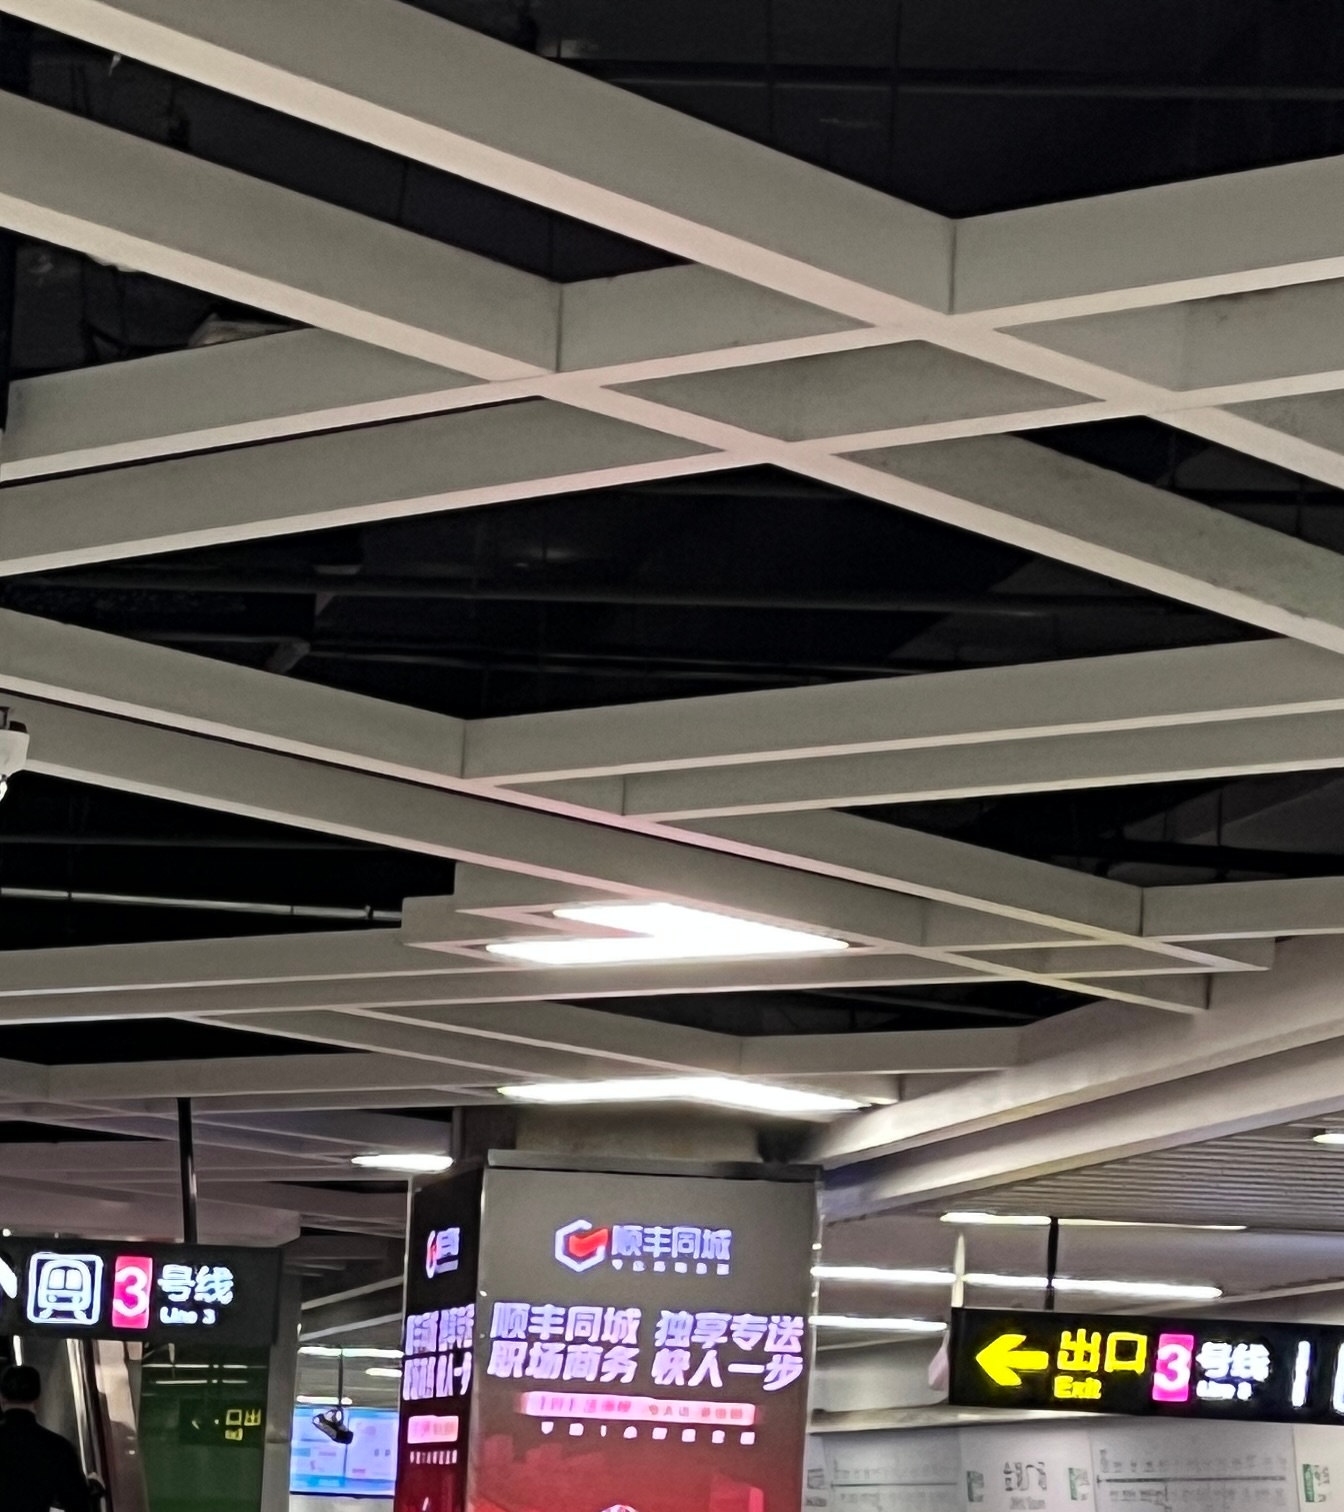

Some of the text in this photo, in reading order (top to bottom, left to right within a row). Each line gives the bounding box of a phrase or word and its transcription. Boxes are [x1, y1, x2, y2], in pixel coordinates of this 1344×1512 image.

[612, 1225, 731, 1260] 顺丰同城
[490, 1302, 804, 1352] 顺丰同城 独享专送
[651, 1348, 803, 1391] 快人一步
[1057, 1329, 1147, 1375] 出口
